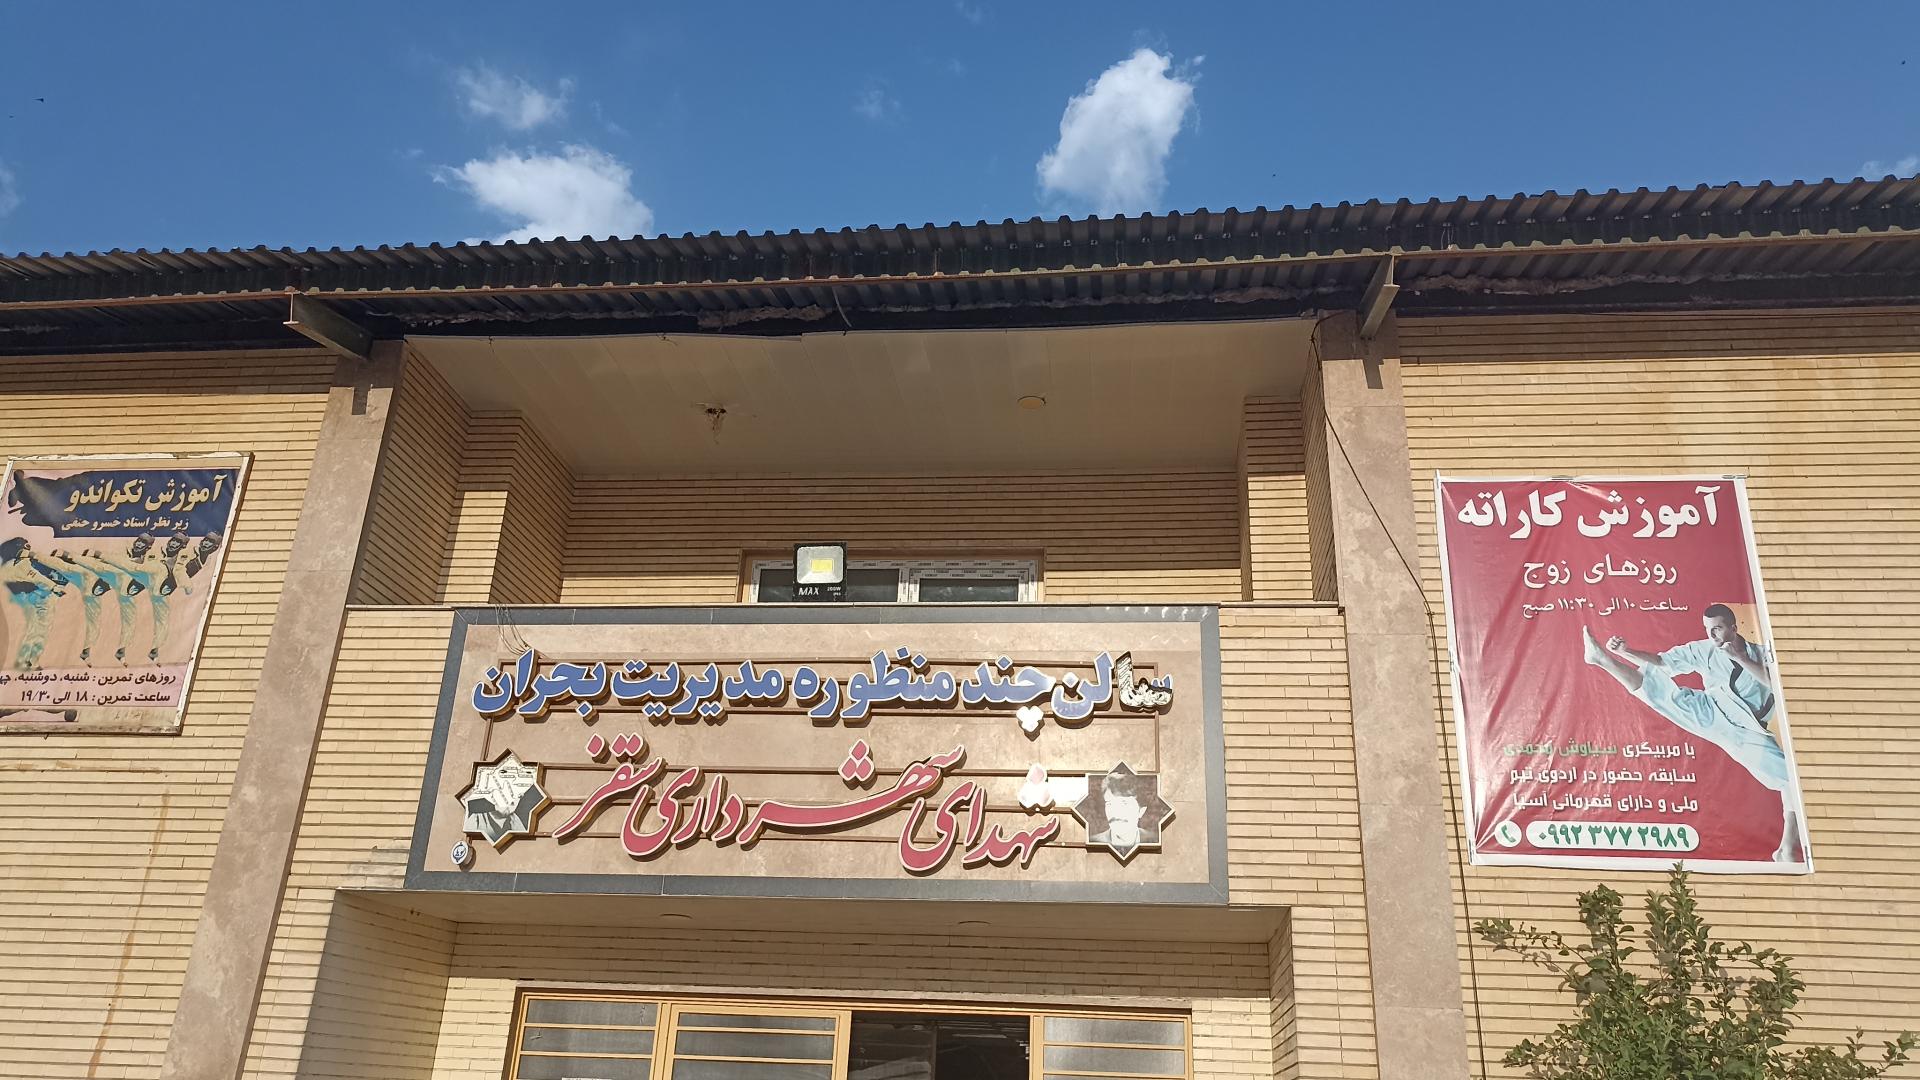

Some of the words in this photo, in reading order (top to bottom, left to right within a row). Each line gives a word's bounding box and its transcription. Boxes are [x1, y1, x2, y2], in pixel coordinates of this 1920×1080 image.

[64, 478, 147, 512] تکواندو
[145, 474, 228, 512] آموزش
[1457, 489, 1567, 539] کاراته
[1577, 485, 1721, 539] آموزش
[61, 516, 90, 531] حنفی
[92, 516, 121, 531] خسرو
[123, 516, 150, 528] استاد
[150, 517, 171, 531] نظر
[173, 517, 189, 531] زیر
[1523, 560, 1571, 588] زوج
[1583, 553, 1678, 585] روزهای
[798, 586, 820, 596] MAX
[1522, 602, 1555, 618] صبح
[1599, 597, 1620, 617] الی
[1623, 598, 1636, 609] ۱۰
[1639, 596, 1688, 612] ساعت
[97, 673, 132, 685] تمرین
[134, 672, 177, 685] روزهای
[472, 648, 607, 717] بحران
[793, 646, 957, 718] منظوره
[1051, 650, 1174, 720] سالن
[76, 691, 88, 702] ۱۸
[134, 691, 171, 702] ساعت
[611, 659, 784, 717] مدیریت
[962, 654, 1057, 733] چند
[53, 690, 71, 705] الی
[97, 692, 132, 705] تمرین
[1559, 737, 1618, 757] سیاوش
[1622, 740, 1680, 758] مربیگری
[1684, 742, 1696, 758] با
[1510, 767, 1535, 784] تیم
[1538, 766, 1578, 784] اردوی
[1582, 769, 1598, 784] در
[1603, 767, 1644, 784] حضور
[1648, 768, 1697, 786] سابقه
[552, 731, 664, 839] سقز
[621, 739, 966, 858] شهرداری
[1553, 793, 1613, 811] قهرمانی
[1616, 796, 1653, 811] دارای
[1658, 798, 1668, 813] و
[1671, 796, 1699, 813] ملی
[900, 763, 1060, 871] شهدای
